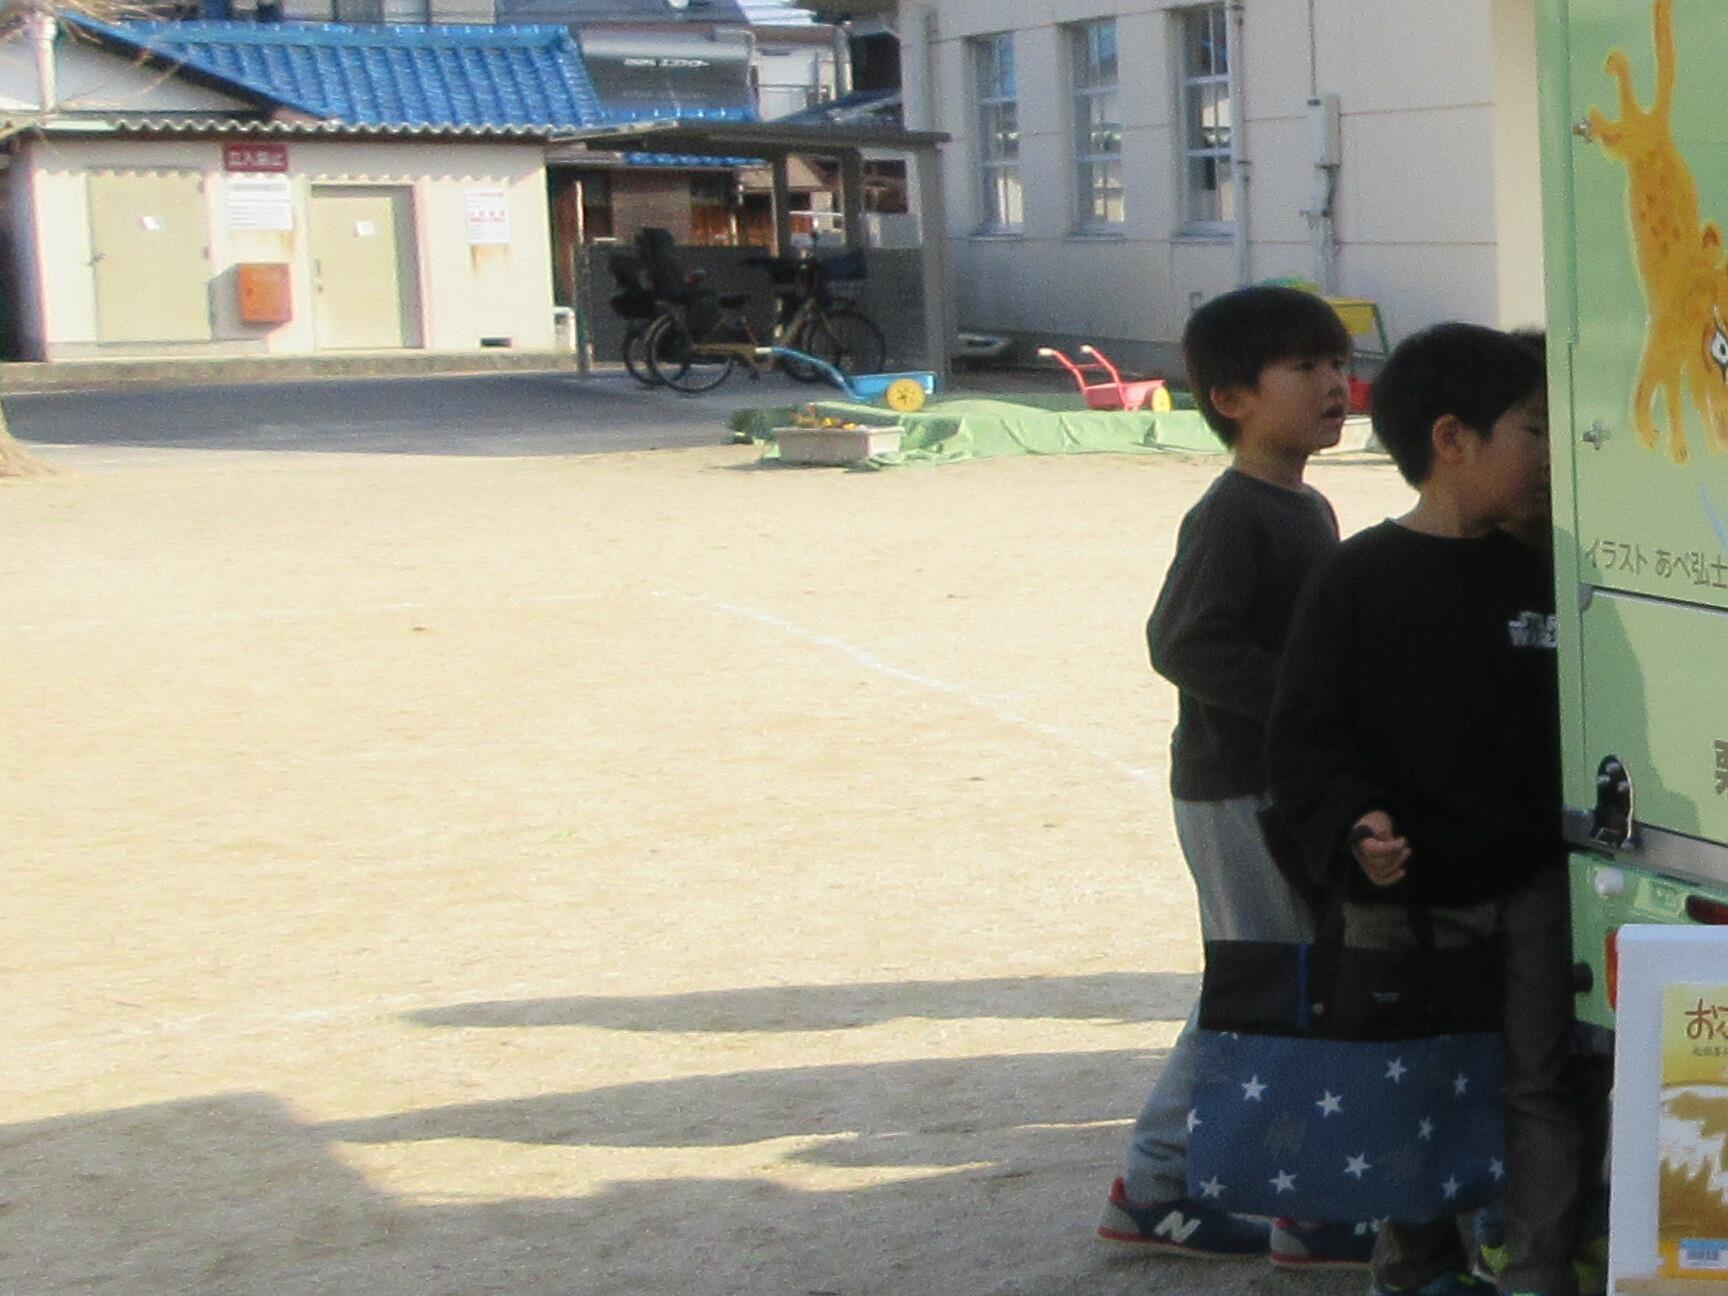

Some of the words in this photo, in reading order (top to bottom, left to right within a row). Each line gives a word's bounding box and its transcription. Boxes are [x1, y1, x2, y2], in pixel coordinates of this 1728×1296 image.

[1585, 538, 1647, 575] イラスト
[1655, 548, 1728, 589] あべ弘士
[1153, 1210, 1202, 1245] N
